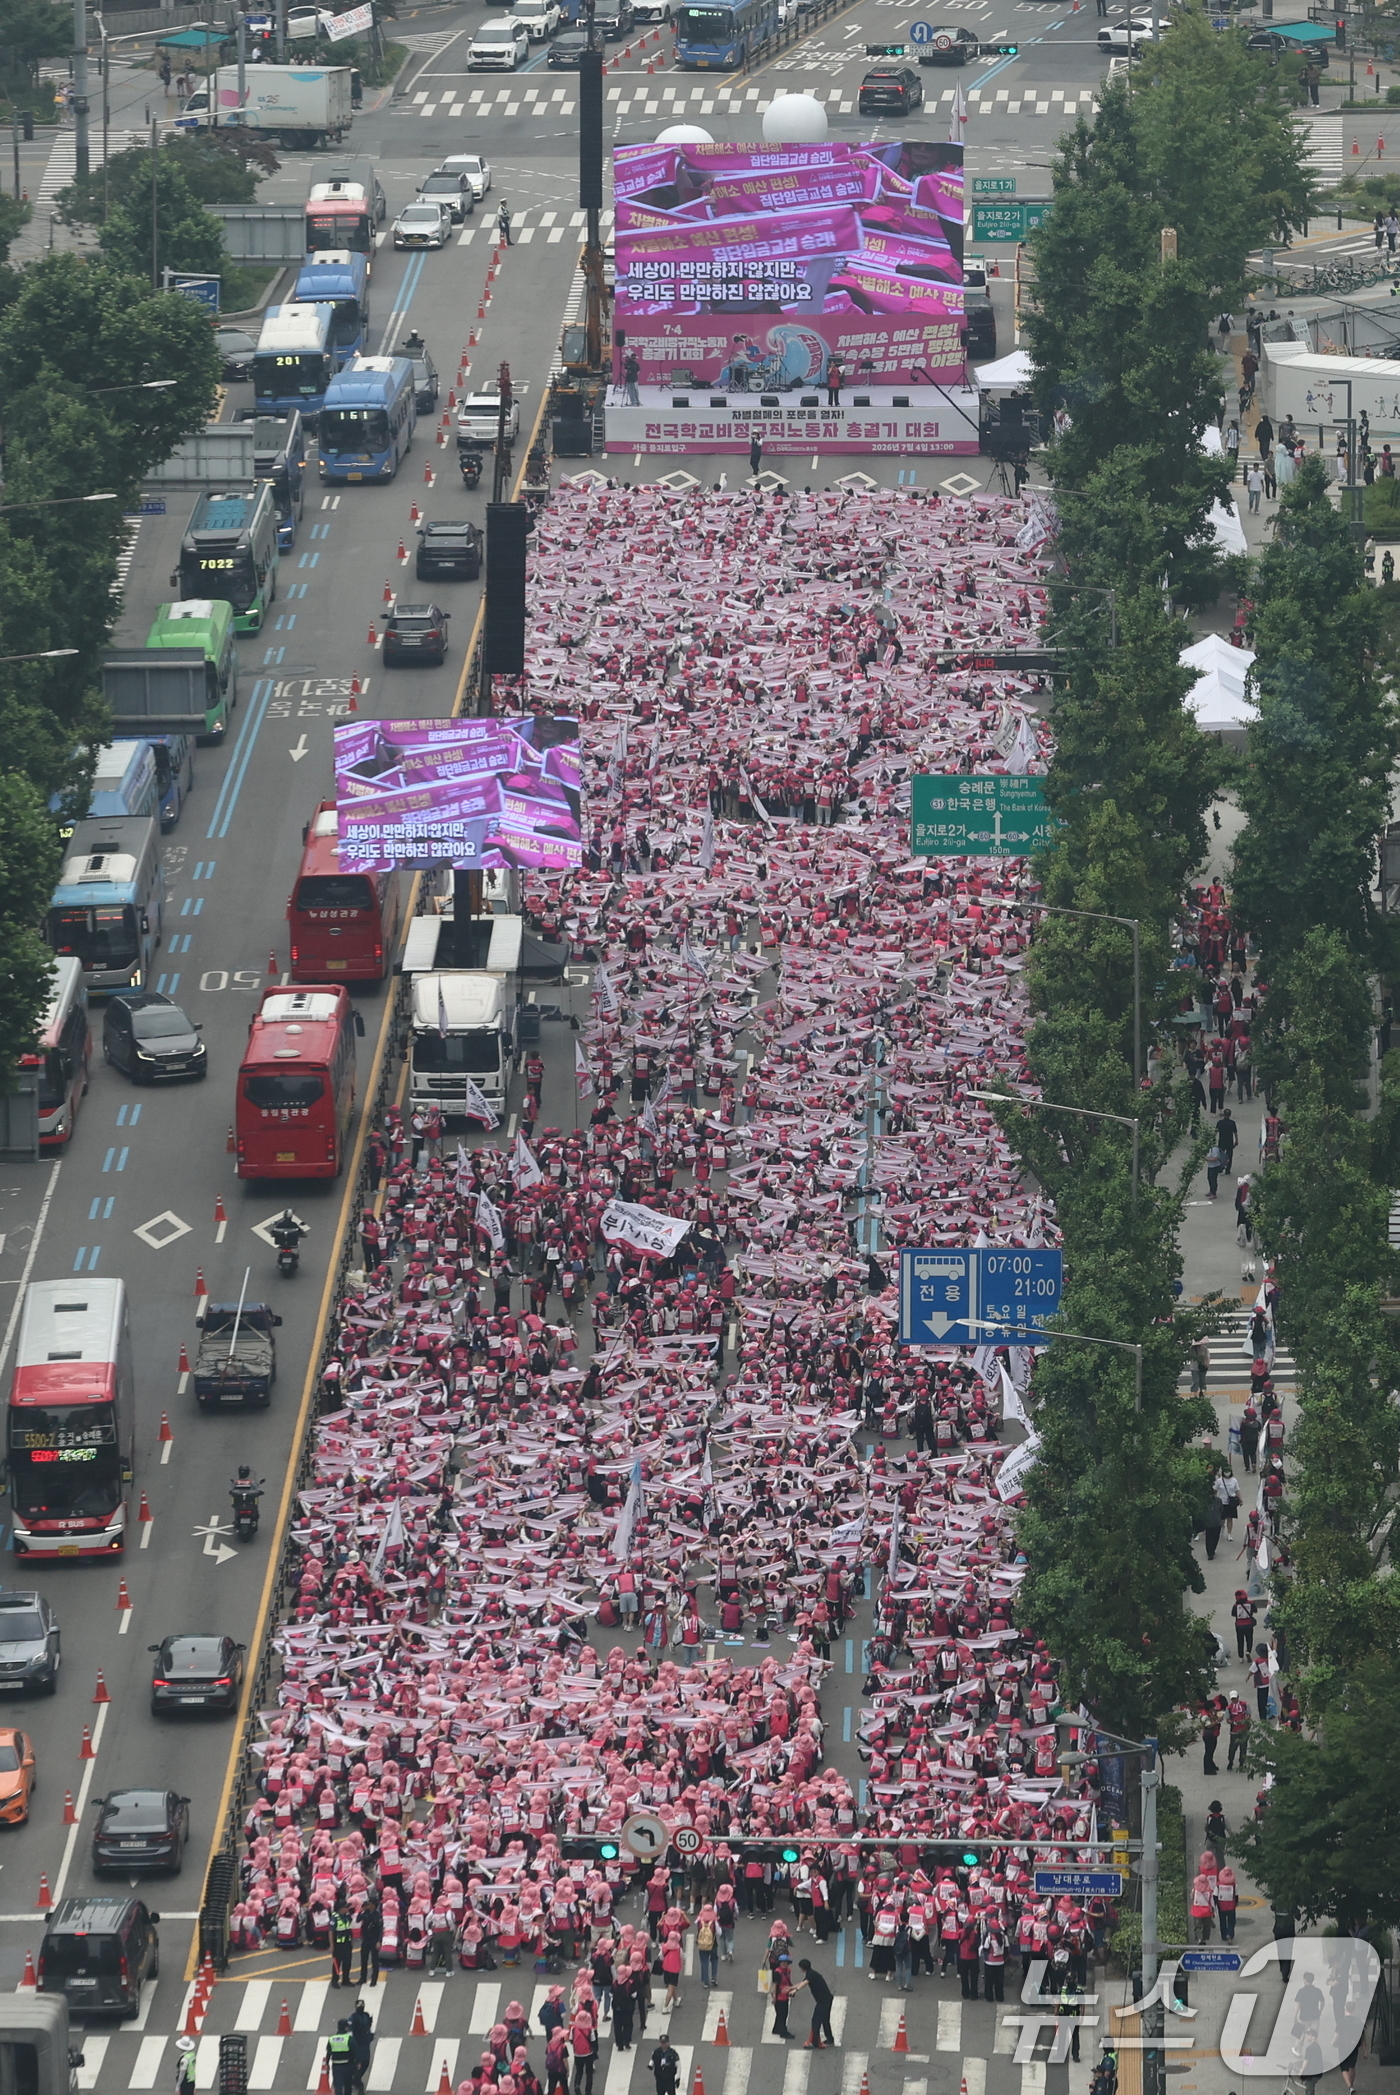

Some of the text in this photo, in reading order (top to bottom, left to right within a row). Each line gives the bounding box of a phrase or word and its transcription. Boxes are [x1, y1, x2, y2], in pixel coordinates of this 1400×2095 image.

[974, 180, 1013, 190] 을지로1가
[977, 211, 1020, 220] 을지로2가
[628, 262, 796, 278] 세상이 만만하지 않지만
[628, 284, 812, 300] 우리도 만만하진 않잖아요
[837, 323, 959, 347] 차별해소 예산 편성!
[276, 356, 300, 366] 201
[340, 410, 368, 420] 161
[646, 422, 940, 439] 전국학교비정규직노동자 총궐기 대회
[200, 558, 234, 569] 7022
[958, 781, 996, 794] 숭례문
[1000, 790, 1037, 799] Sungnyemun
[934, 798, 996, 812] 31 한국은행
[1000, 803, 1011, 812] The
[1034, 804, 1051, 812] Korea
[346, 823, 464, 840] 세상이 만만하지 않지만
[915, 824, 966, 837] 을지로2가
[916, 838, 939, 847] Euljiro
[346, 842, 476, 859] 우리도 만만하진 않잖아요
[200, 971, 260, 992] 50
[1015, 1278, 1055, 1296] 21:00
[678, 1832, 696, 1848] 50
[1053, 1875, 1091, 1885] 남대문로
